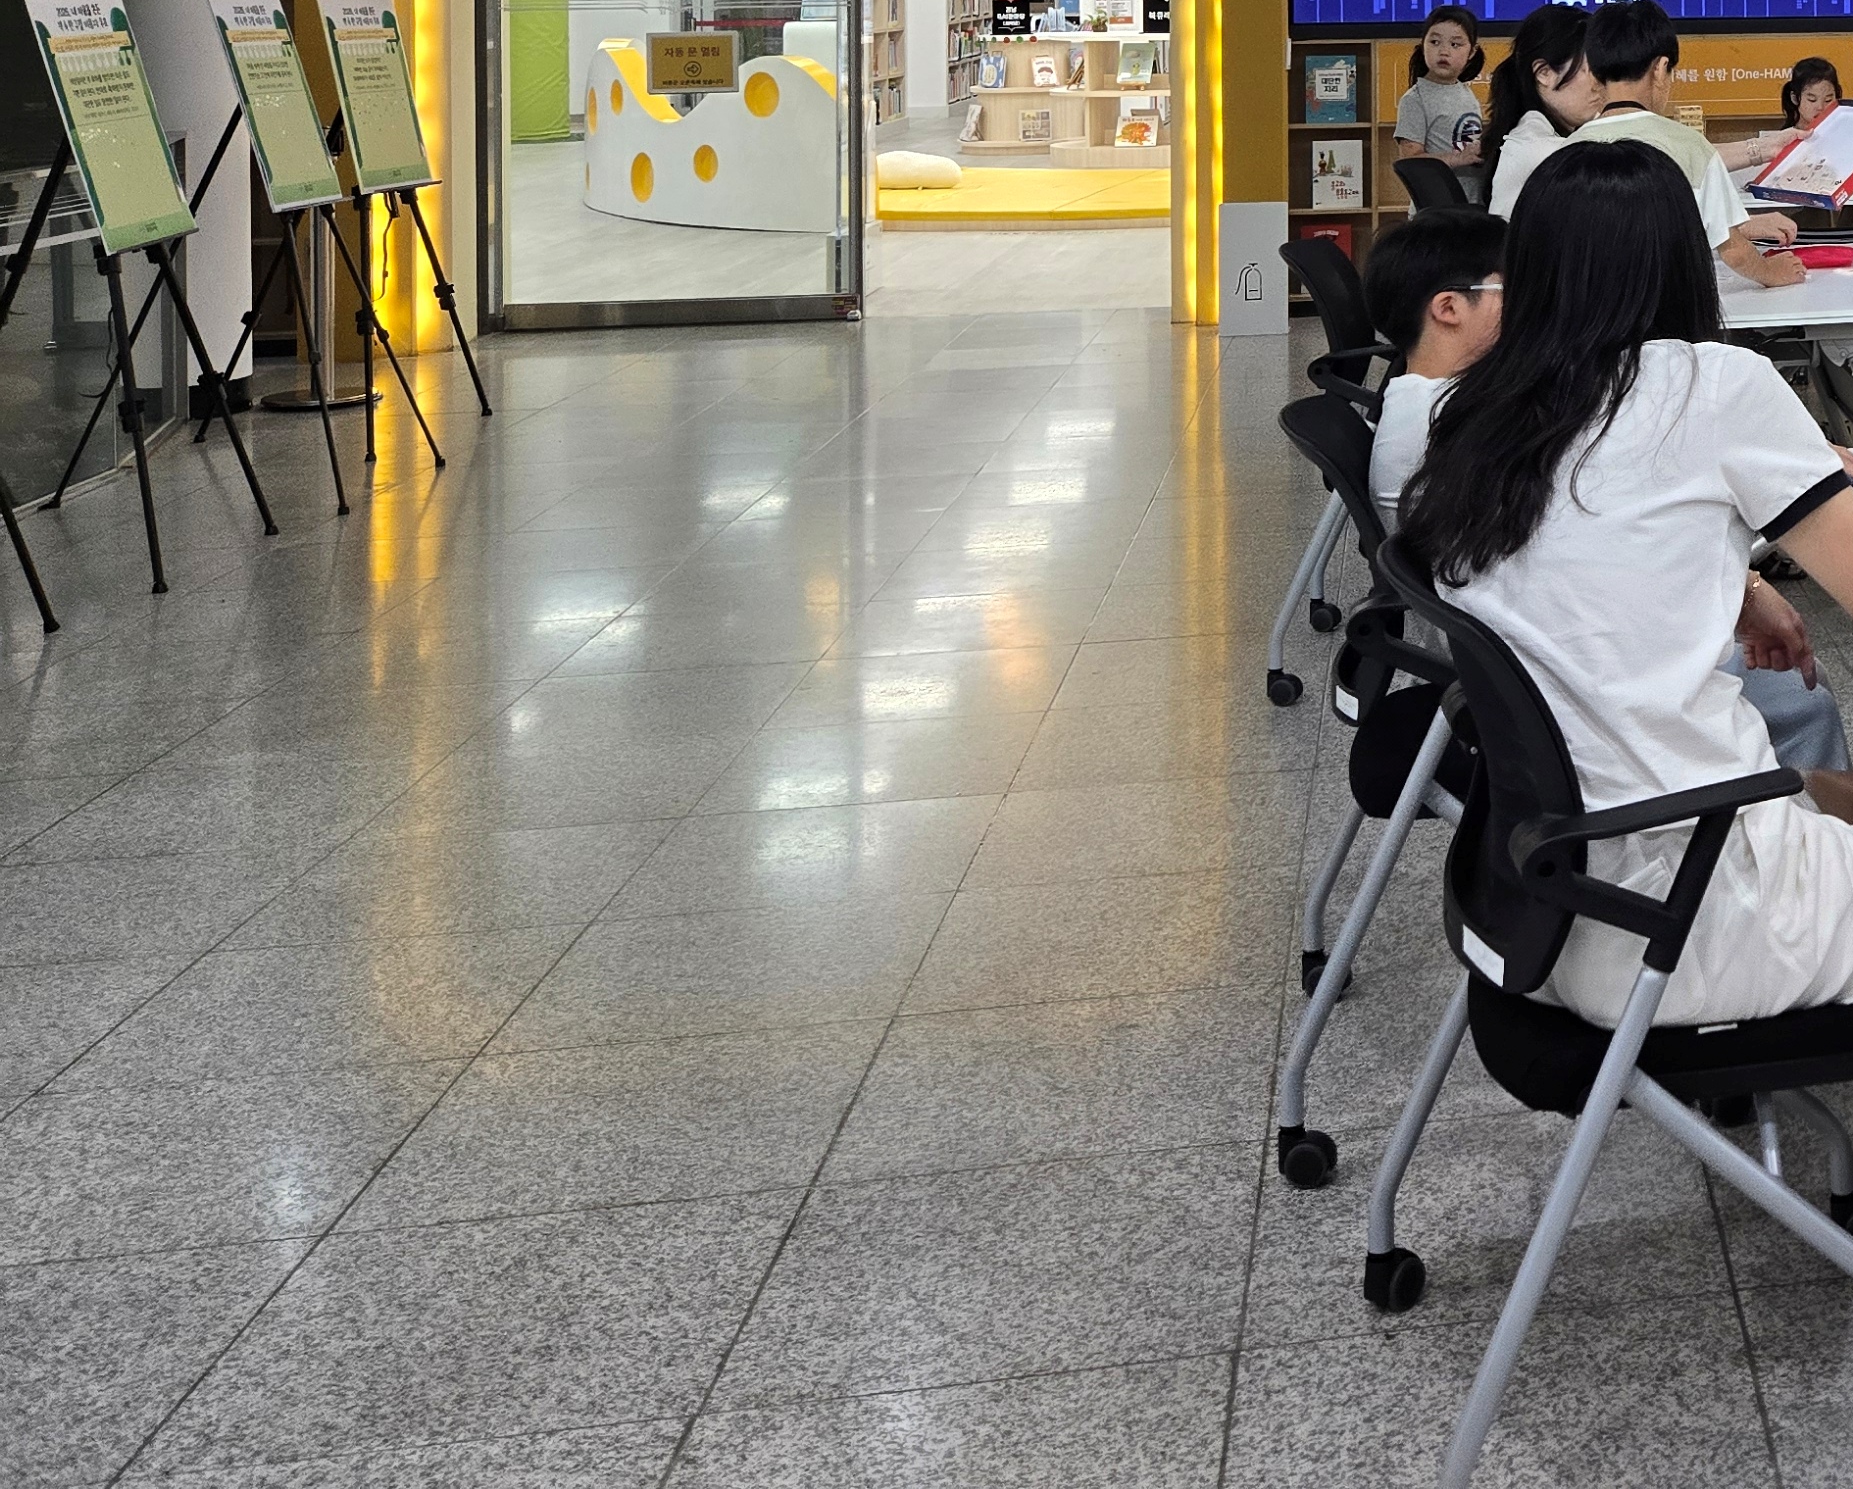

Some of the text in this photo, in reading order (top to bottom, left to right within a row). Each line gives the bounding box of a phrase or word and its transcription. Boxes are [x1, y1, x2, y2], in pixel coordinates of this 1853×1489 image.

[664, 46, 720, 58] 자동 문 열림
[1703, 67, 1728, 83] 원함
